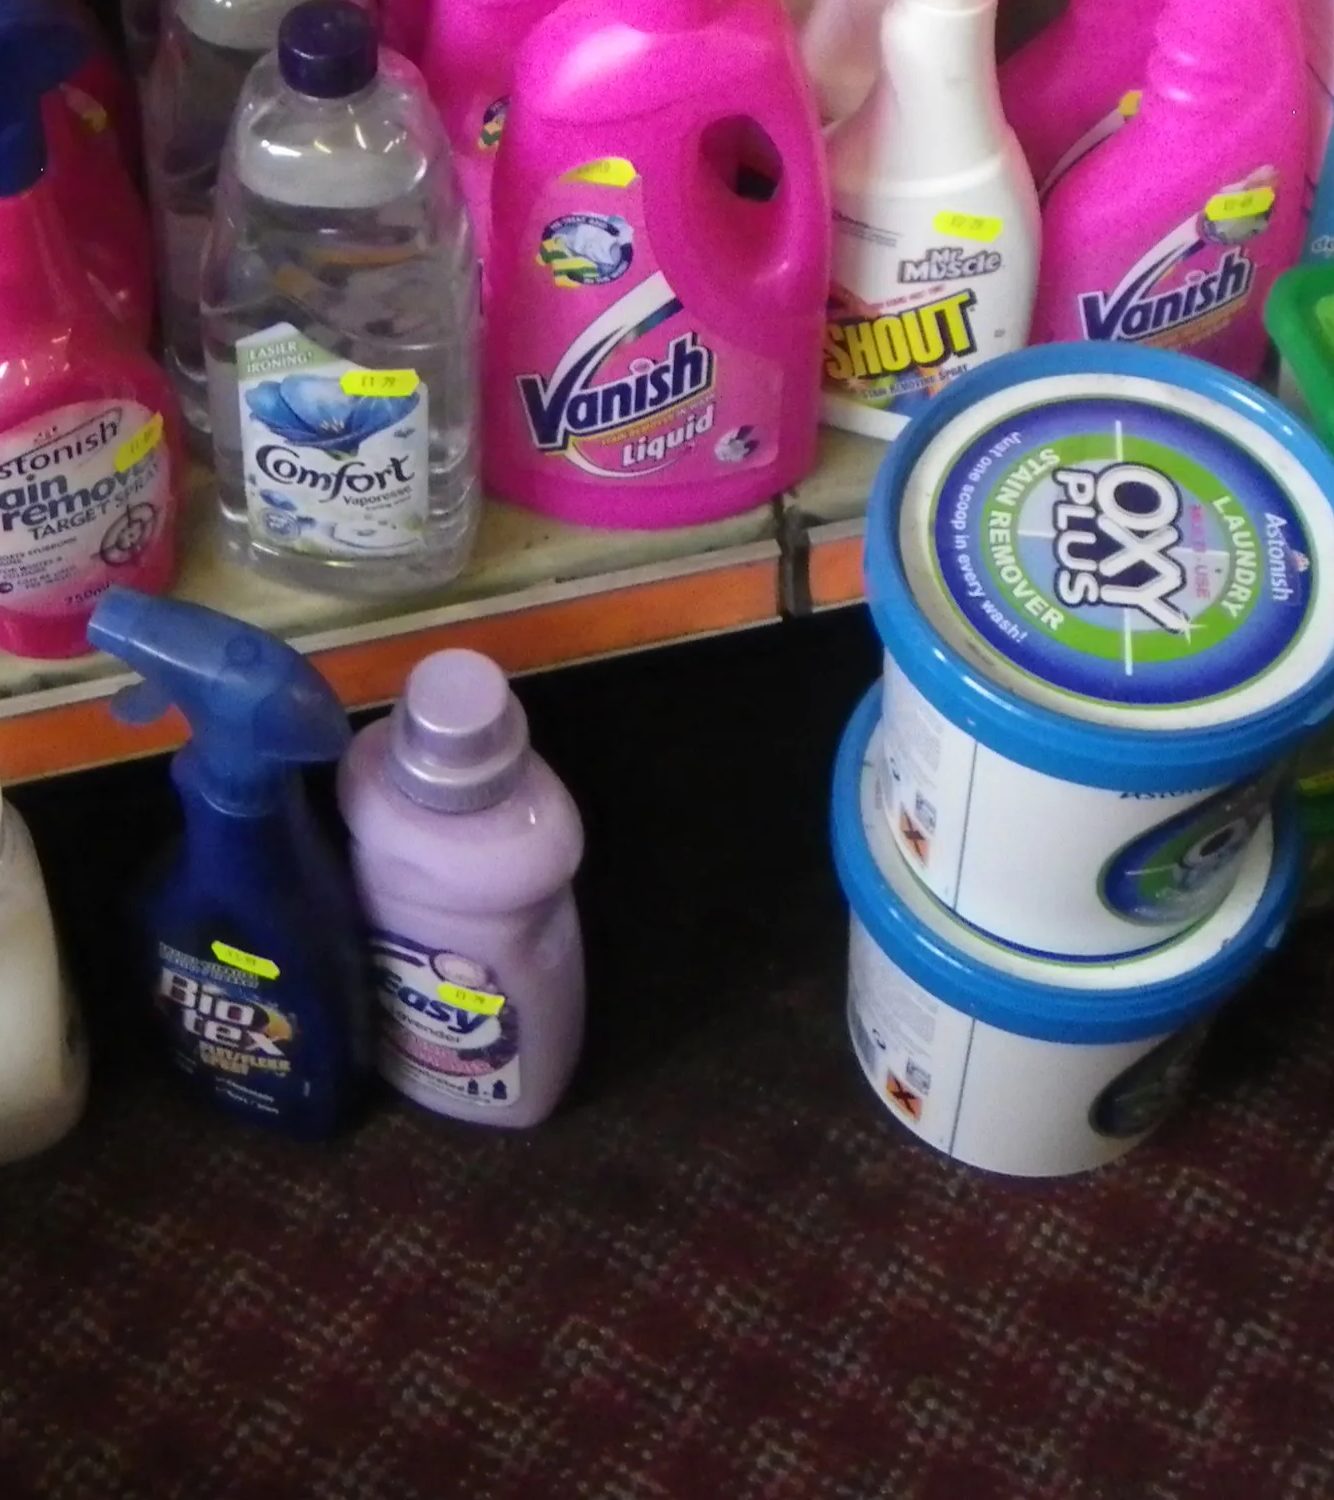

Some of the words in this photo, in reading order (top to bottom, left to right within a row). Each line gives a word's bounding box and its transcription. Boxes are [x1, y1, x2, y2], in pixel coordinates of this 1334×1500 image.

[1078, 250, 1257, 343] Vanish
[247, 340, 299, 361] EASIER
[822, 289, 975, 381] SHOUT
[517, 332, 716, 451] Vanish
[622, 403, 715, 467] Liquid
[255, 443, 416, 504] Comfort
[995, 447, 1061, 507] STAIN
[27, 501, 113, 541] TARGET
[950, 481, 976, 531] scoop
[1052, 467, 1099, 608] PLUS
[1095, 461, 1191, 634] OXY
[1212, 495, 1258, 619] LAUNDRY
[1265, 512, 1294, 601] Astonish
[957, 554, 986, 599] every
[988, 510, 1065, 631] REMOVER
[161, 967, 257, 1026] Bio
[393, 1008, 461, 1045] avender
[183, 1007, 287, 1058] tex
